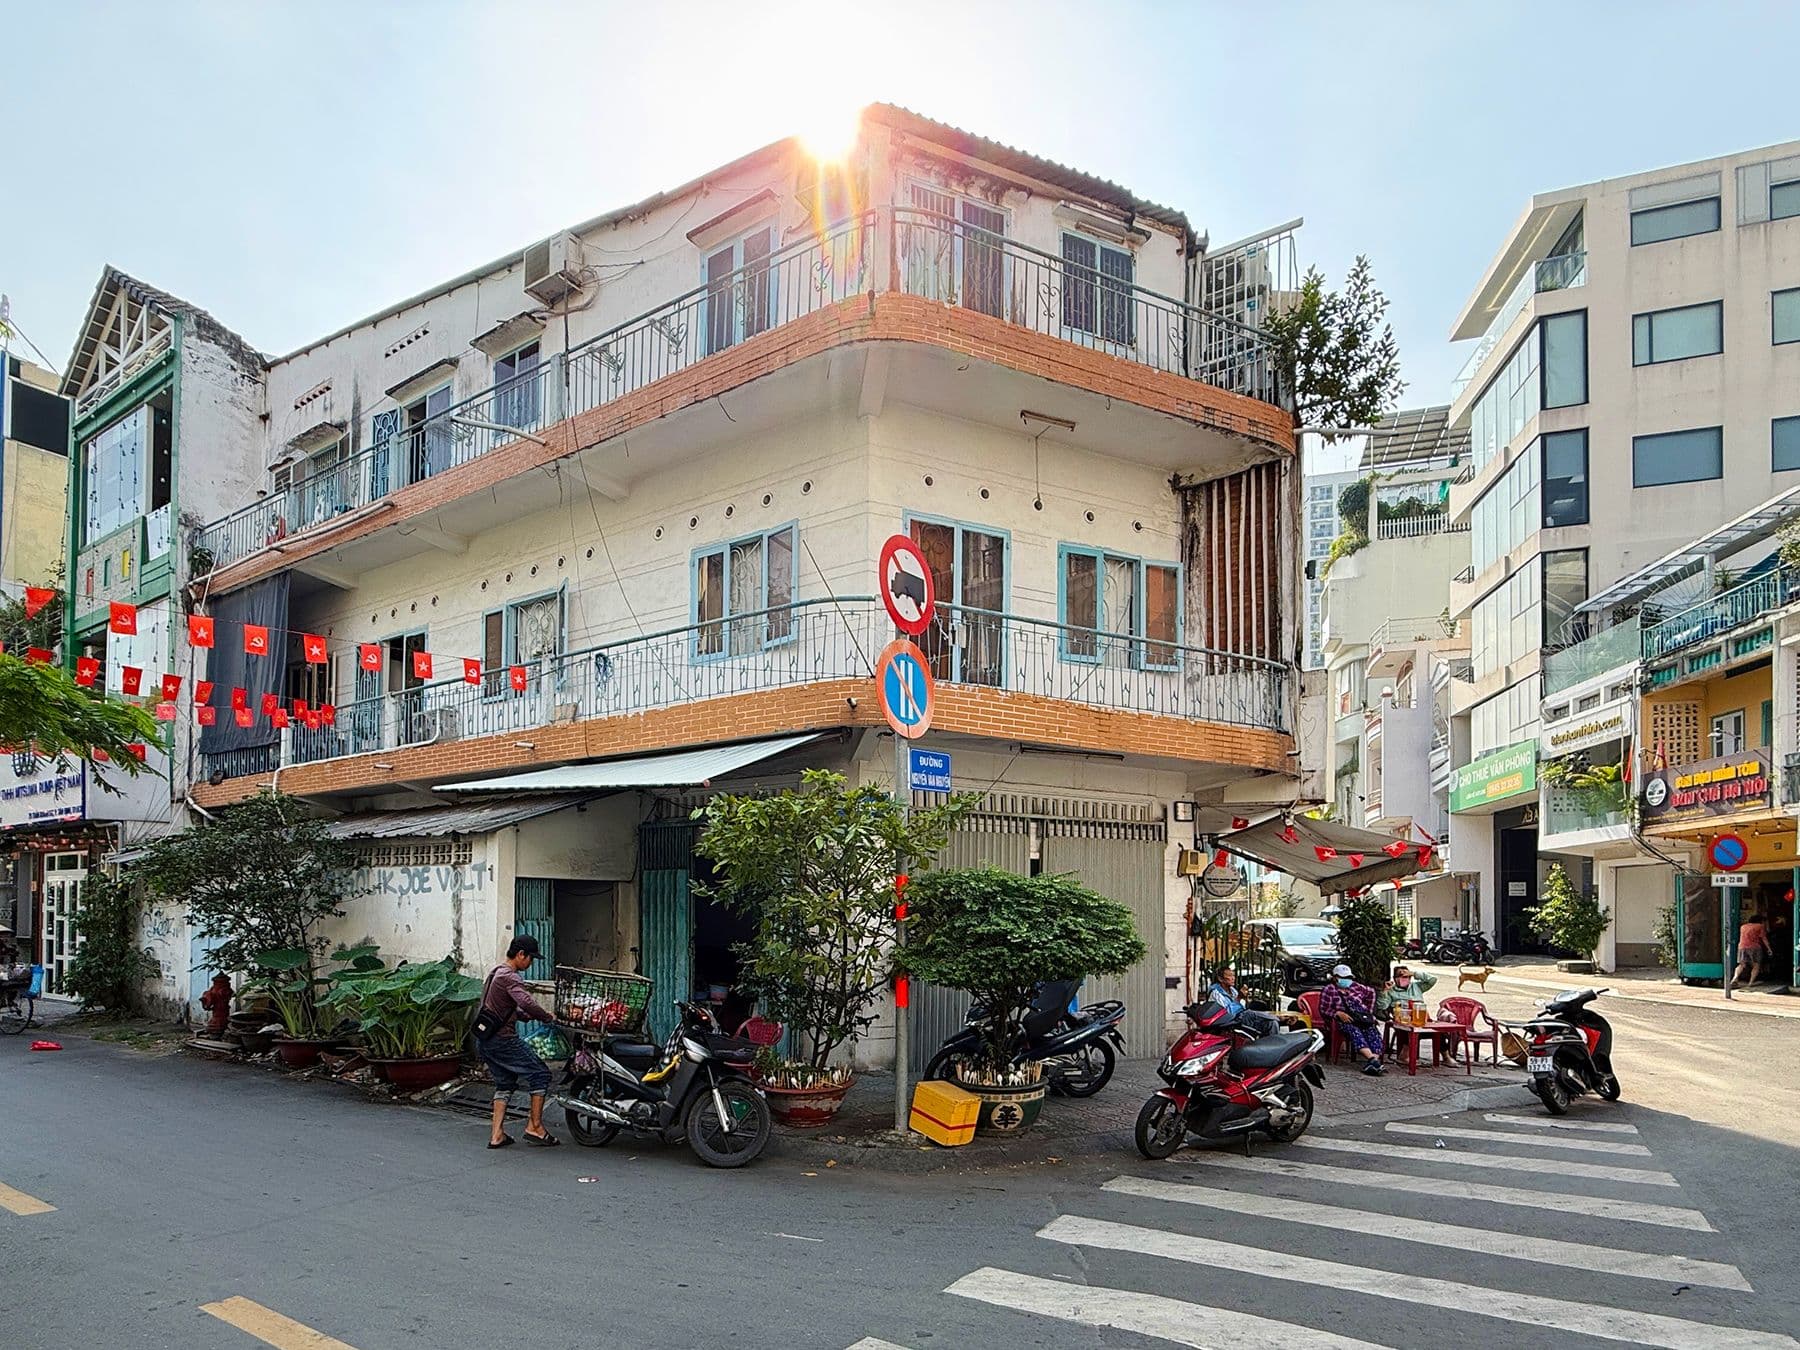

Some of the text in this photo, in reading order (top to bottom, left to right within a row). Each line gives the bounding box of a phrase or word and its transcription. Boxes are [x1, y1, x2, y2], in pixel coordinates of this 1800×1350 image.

[919, 756, 943, 768] ĐƯỜNG
[1459, 771, 1472, 788] CHO
[1472, 763, 1489, 783] THUÊ
[1489, 759, 1504, 776] VĂN
[1505, 750, 1531, 772] PHÒNG
[398, 865, 432, 896] JOE
[436, 859, 487, 893] VOLT
